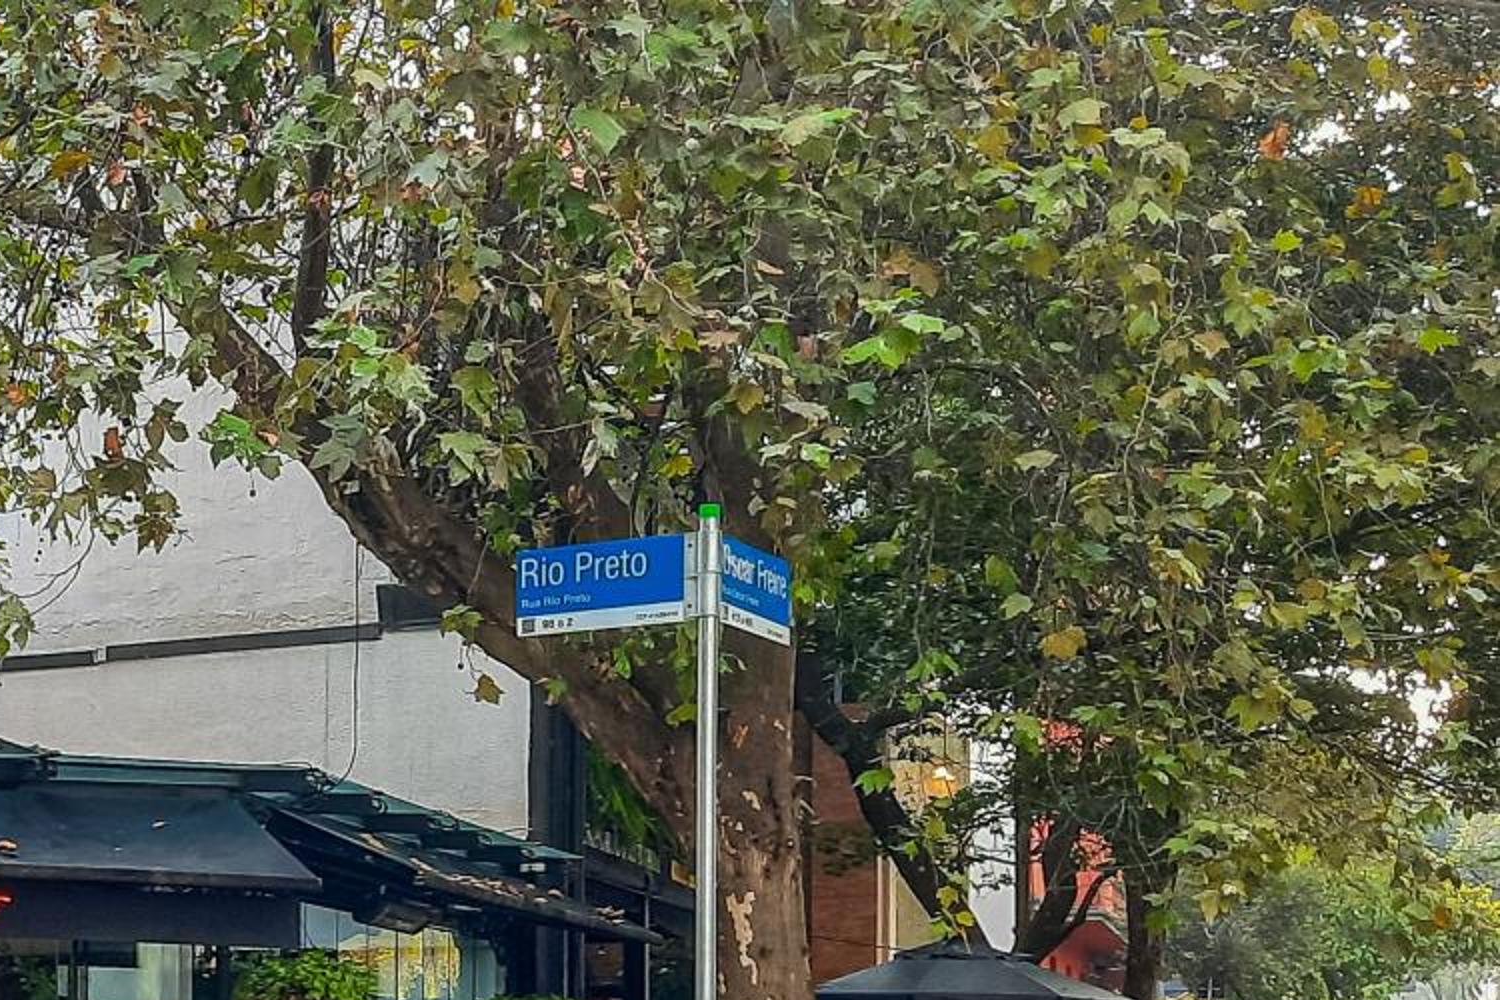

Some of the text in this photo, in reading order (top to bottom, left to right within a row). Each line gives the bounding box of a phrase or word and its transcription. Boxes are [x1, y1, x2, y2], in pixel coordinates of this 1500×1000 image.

[520, 549, 648, 589] Rio Preto
[723, 543, 755, 585] Oscar
[757, 559, 787, 599] Freire
[520, 593, 592, 609] Rua Rio Preto
